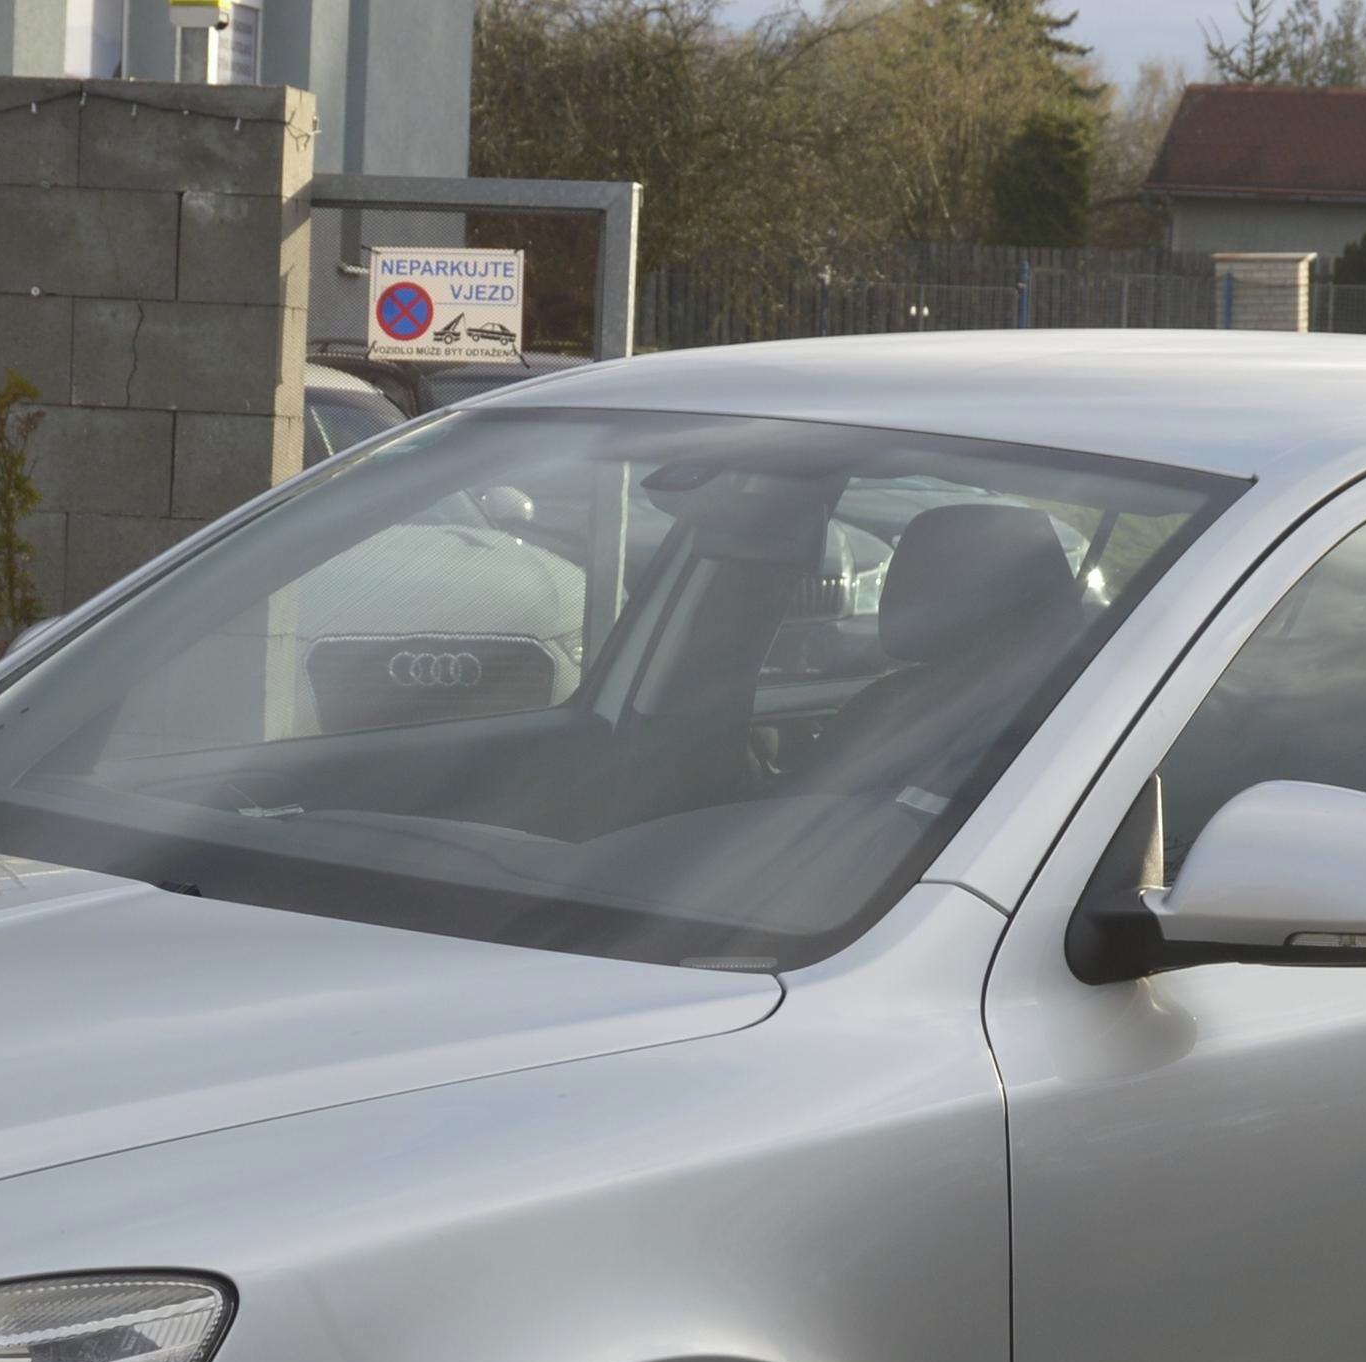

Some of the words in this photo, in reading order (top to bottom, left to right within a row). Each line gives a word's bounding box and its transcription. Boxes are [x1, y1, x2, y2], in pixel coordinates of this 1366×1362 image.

[381, 260, 515, 278] NEPARKUJTE
[450, 285, 515, 301] VJEZD
[373, 346, 414, 355] VOZIDLO
